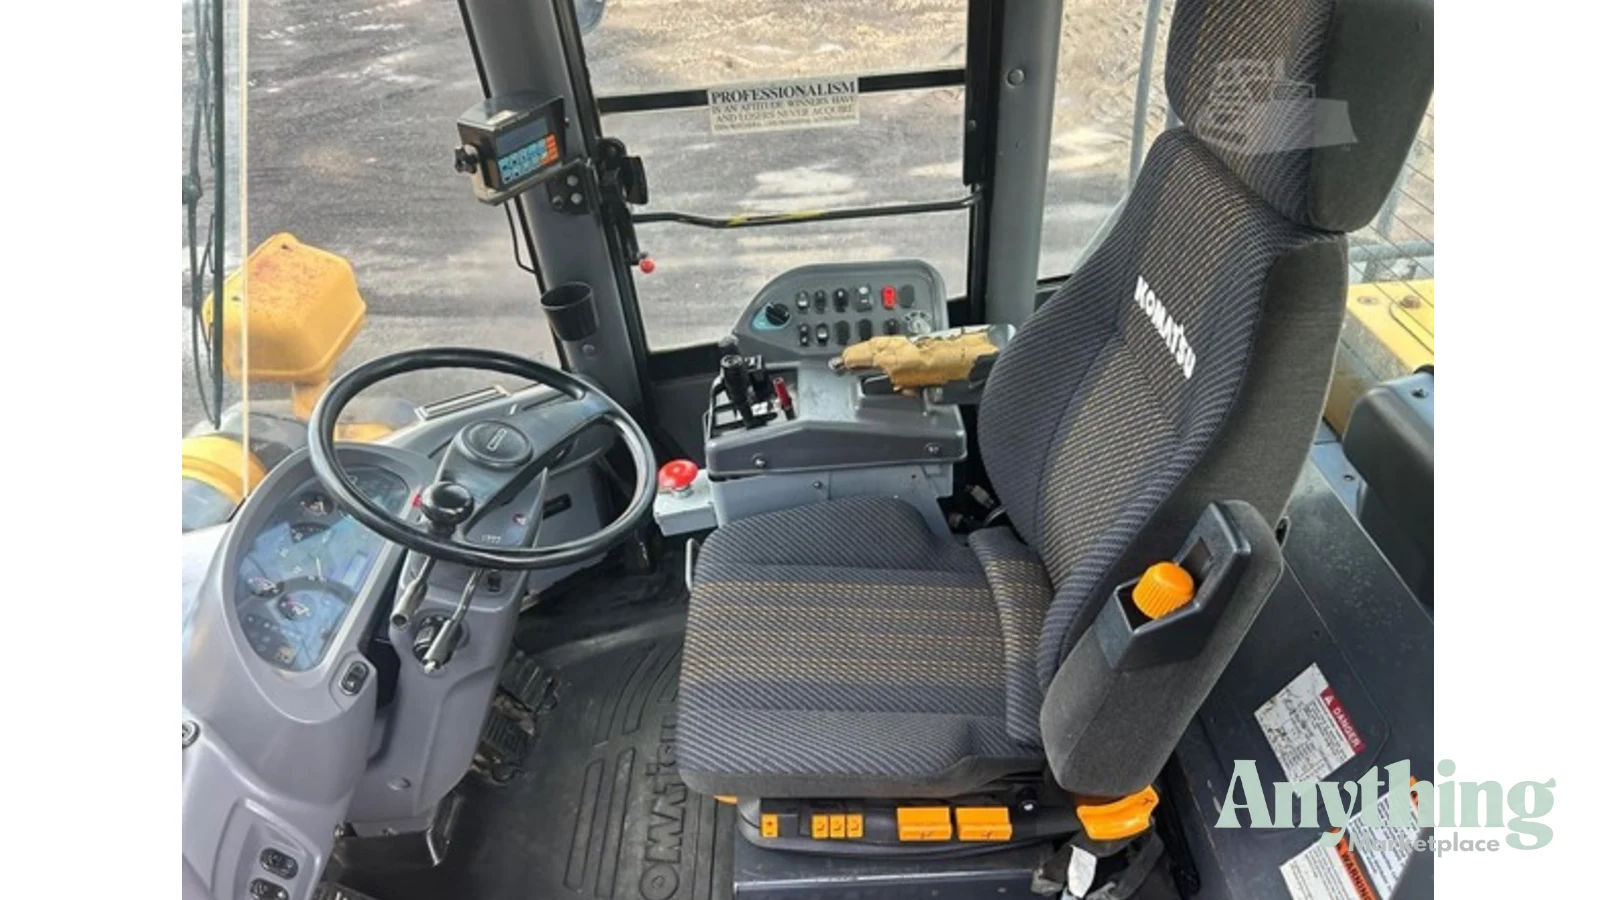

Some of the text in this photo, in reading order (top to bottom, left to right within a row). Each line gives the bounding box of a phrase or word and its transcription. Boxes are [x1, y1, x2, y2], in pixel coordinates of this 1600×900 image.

[711, 80, 857, 105] PROFESSIONALISM
[1134, 275, 1196, 379] KOMATSU
[1332, 707, 1362, 748] DANGER
